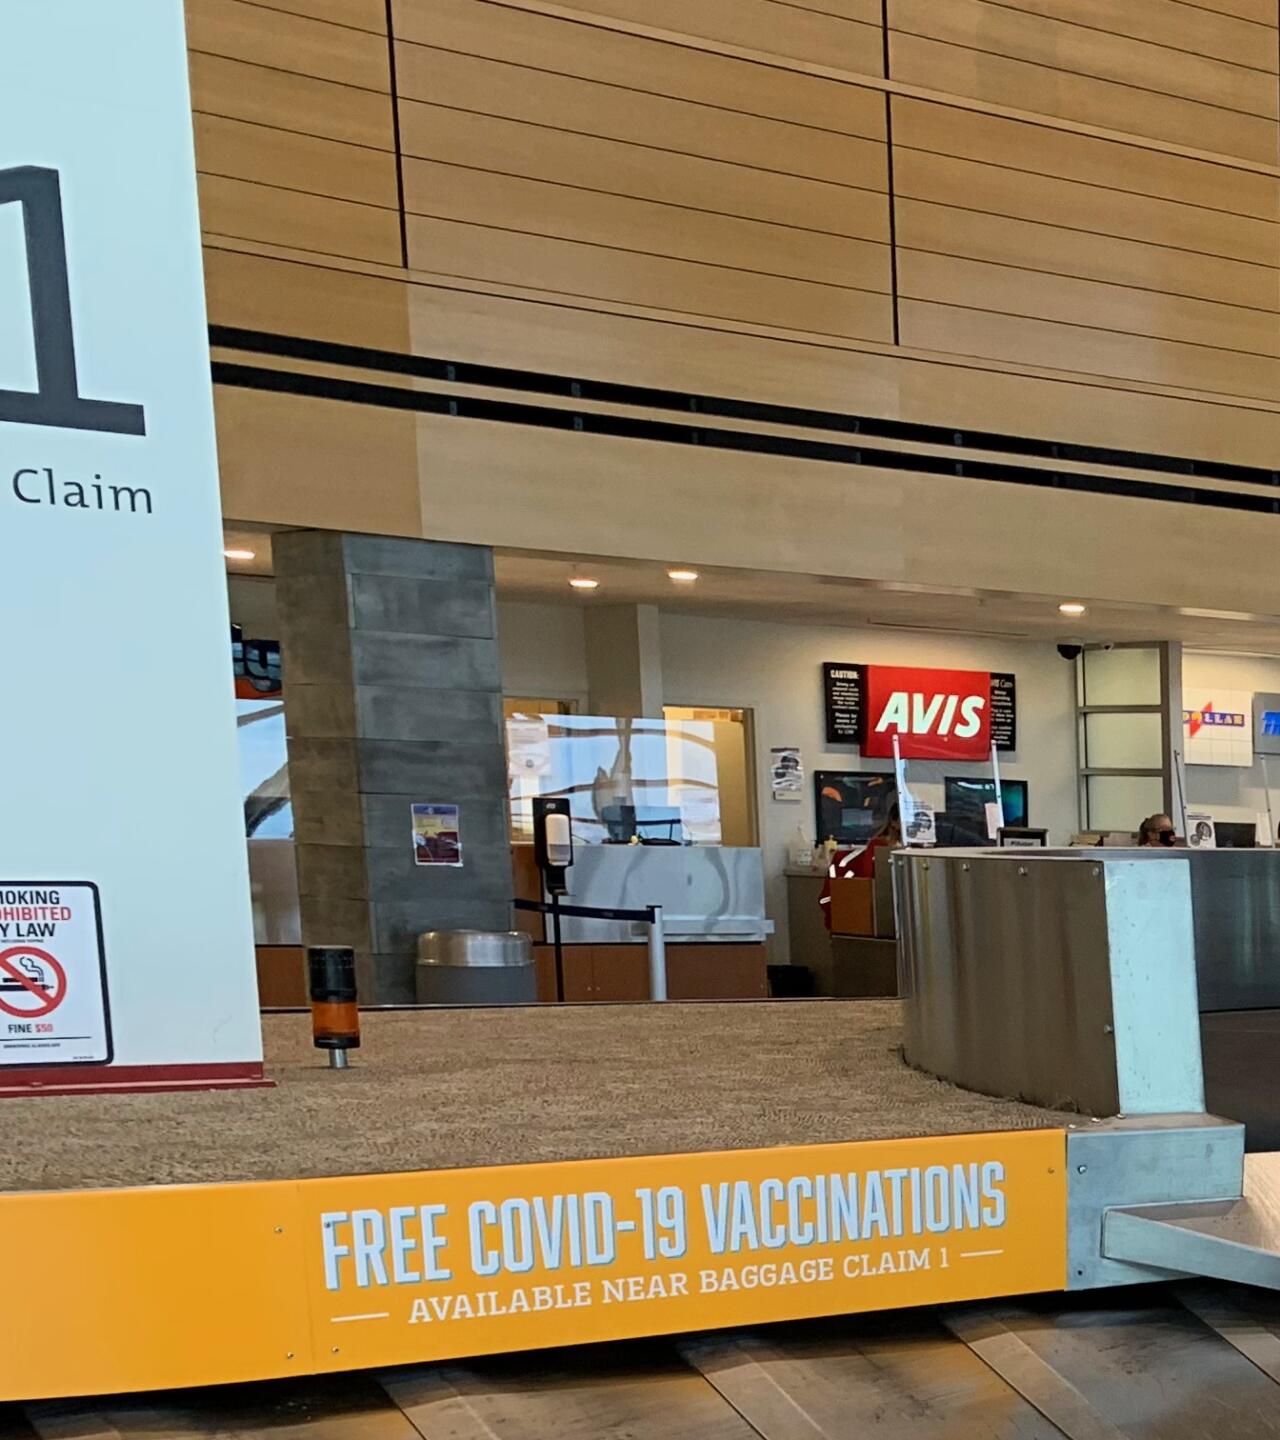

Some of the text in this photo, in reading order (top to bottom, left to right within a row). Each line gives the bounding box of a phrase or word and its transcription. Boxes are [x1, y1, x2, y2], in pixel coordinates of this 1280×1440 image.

[12, 467, 152, 514] Claim
[874, 691, 986, 738] AVIS
[16, 922, 56, 938] LAW
[8, 1023, 54, 1034] FINE $50
[320, 1160, 1006, 1291] FREE COVID-19 VACCINATIONS
[408, 1246, 950, 1324] AVAILABLE NEAR BAGGAGE CLAIM 1
